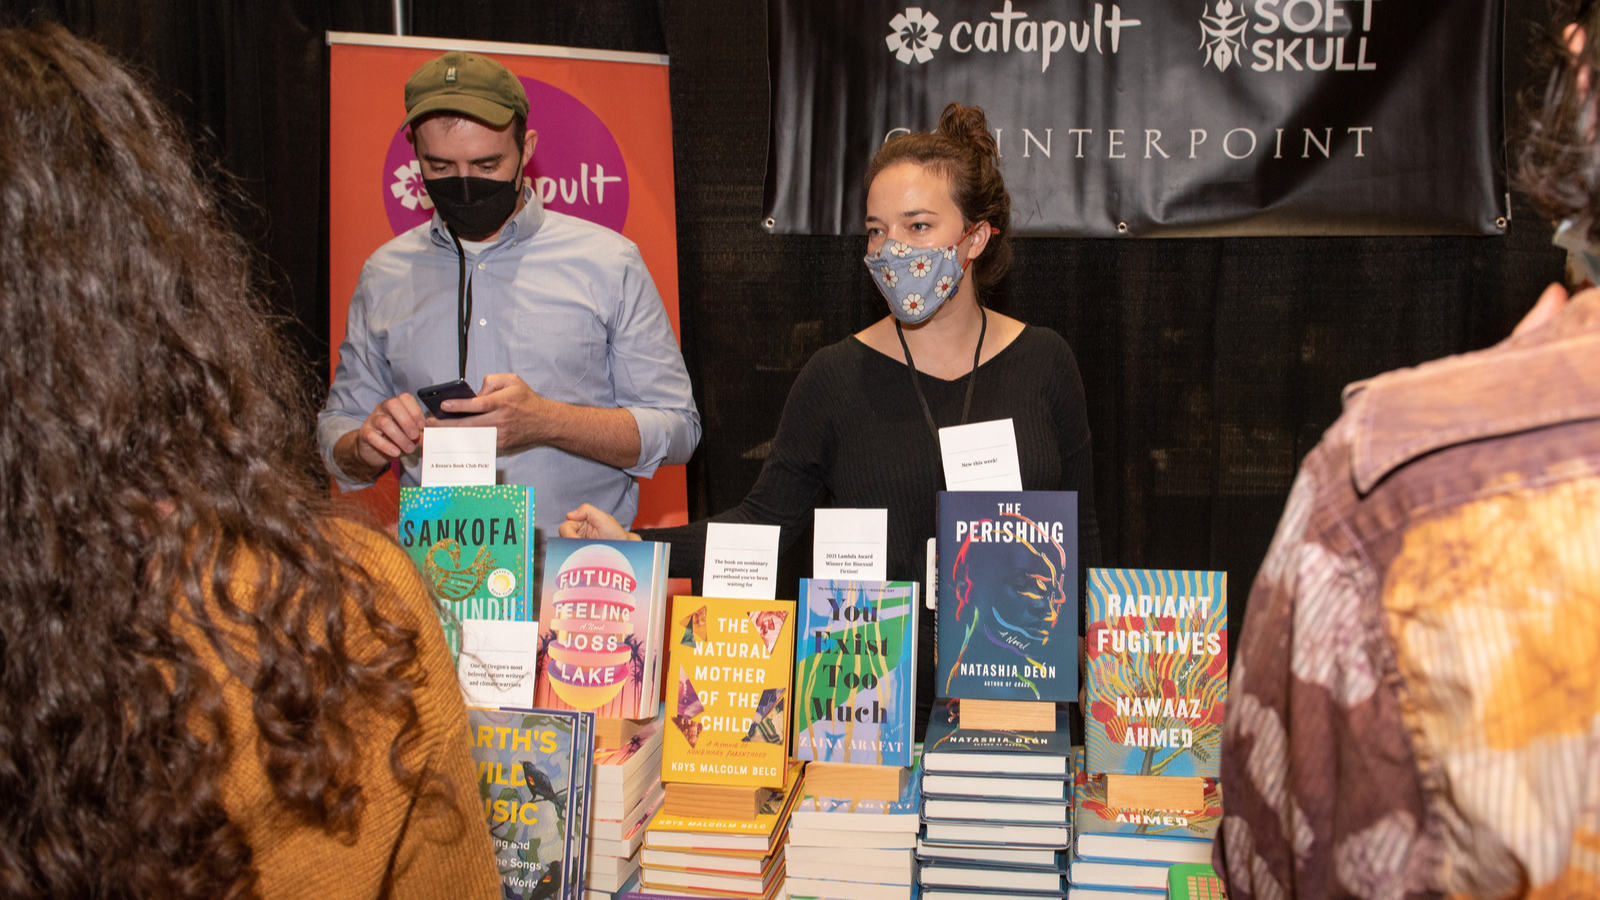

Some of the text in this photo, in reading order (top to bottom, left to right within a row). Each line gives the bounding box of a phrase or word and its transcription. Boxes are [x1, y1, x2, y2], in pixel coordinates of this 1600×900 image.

[1252, 0, 1373, 34] SOFT
[949, 0, 1142, 73] catapult
[1250, 36, 1377, 72] SKULL
[884, 127, 1373, 159] NTERPOINT
[523, 162, 622, 206] pult
[998, 503, 1021, 516] THE
[403, 517, 517, 548] SANKOFA
[956, 521, 1064, 543] PERISHING
[560, 570, 631, 593] FUTURE
[440, 598, 516, 626] BUNDU
[555, 602, 630, 620] FEELING
[827, 598, 878, 622] You
[1108, 594, 1211, 619] RADIANT
[718, 617, 750, 633] THE
[565, 633, 618, 651] JOSS
[693, 641, 770, 659] NATURAL
[814, 630, 889, 657] Exist
[1006, 636, 1031, 650] Novel
[1097, 629, 1221, 655] FUGITIVES
[562, 664, 615, 684] LAKE
[695, 666, 766, 684] MOTHER
[823, 664, 878, 690] Too
[960, 662, 1056, 679] NATASHIA DEÓN
[698, 690, 760, 708] OF THE
[1116, 697, 1202, 718] NAWAAZ
[810, 696, 888, 724] Much
[701, 716, 752, 733] CHILD
[468, 725, 557, 754] RTH'S
[800, 736, 904, 752] ZAINA ARAFAT
[1123, 727, 1193, 748] AHMED
[671, 762, 777, 776] KRYS MALCOLM BELC
[485, 798, 539, 825] SIC
[1115, 814, 1188, 826] AHMED
[511, 841, 530, 850] and
[496, 857, 542, 872] he Songs
[508, 876, 538, 888] World
